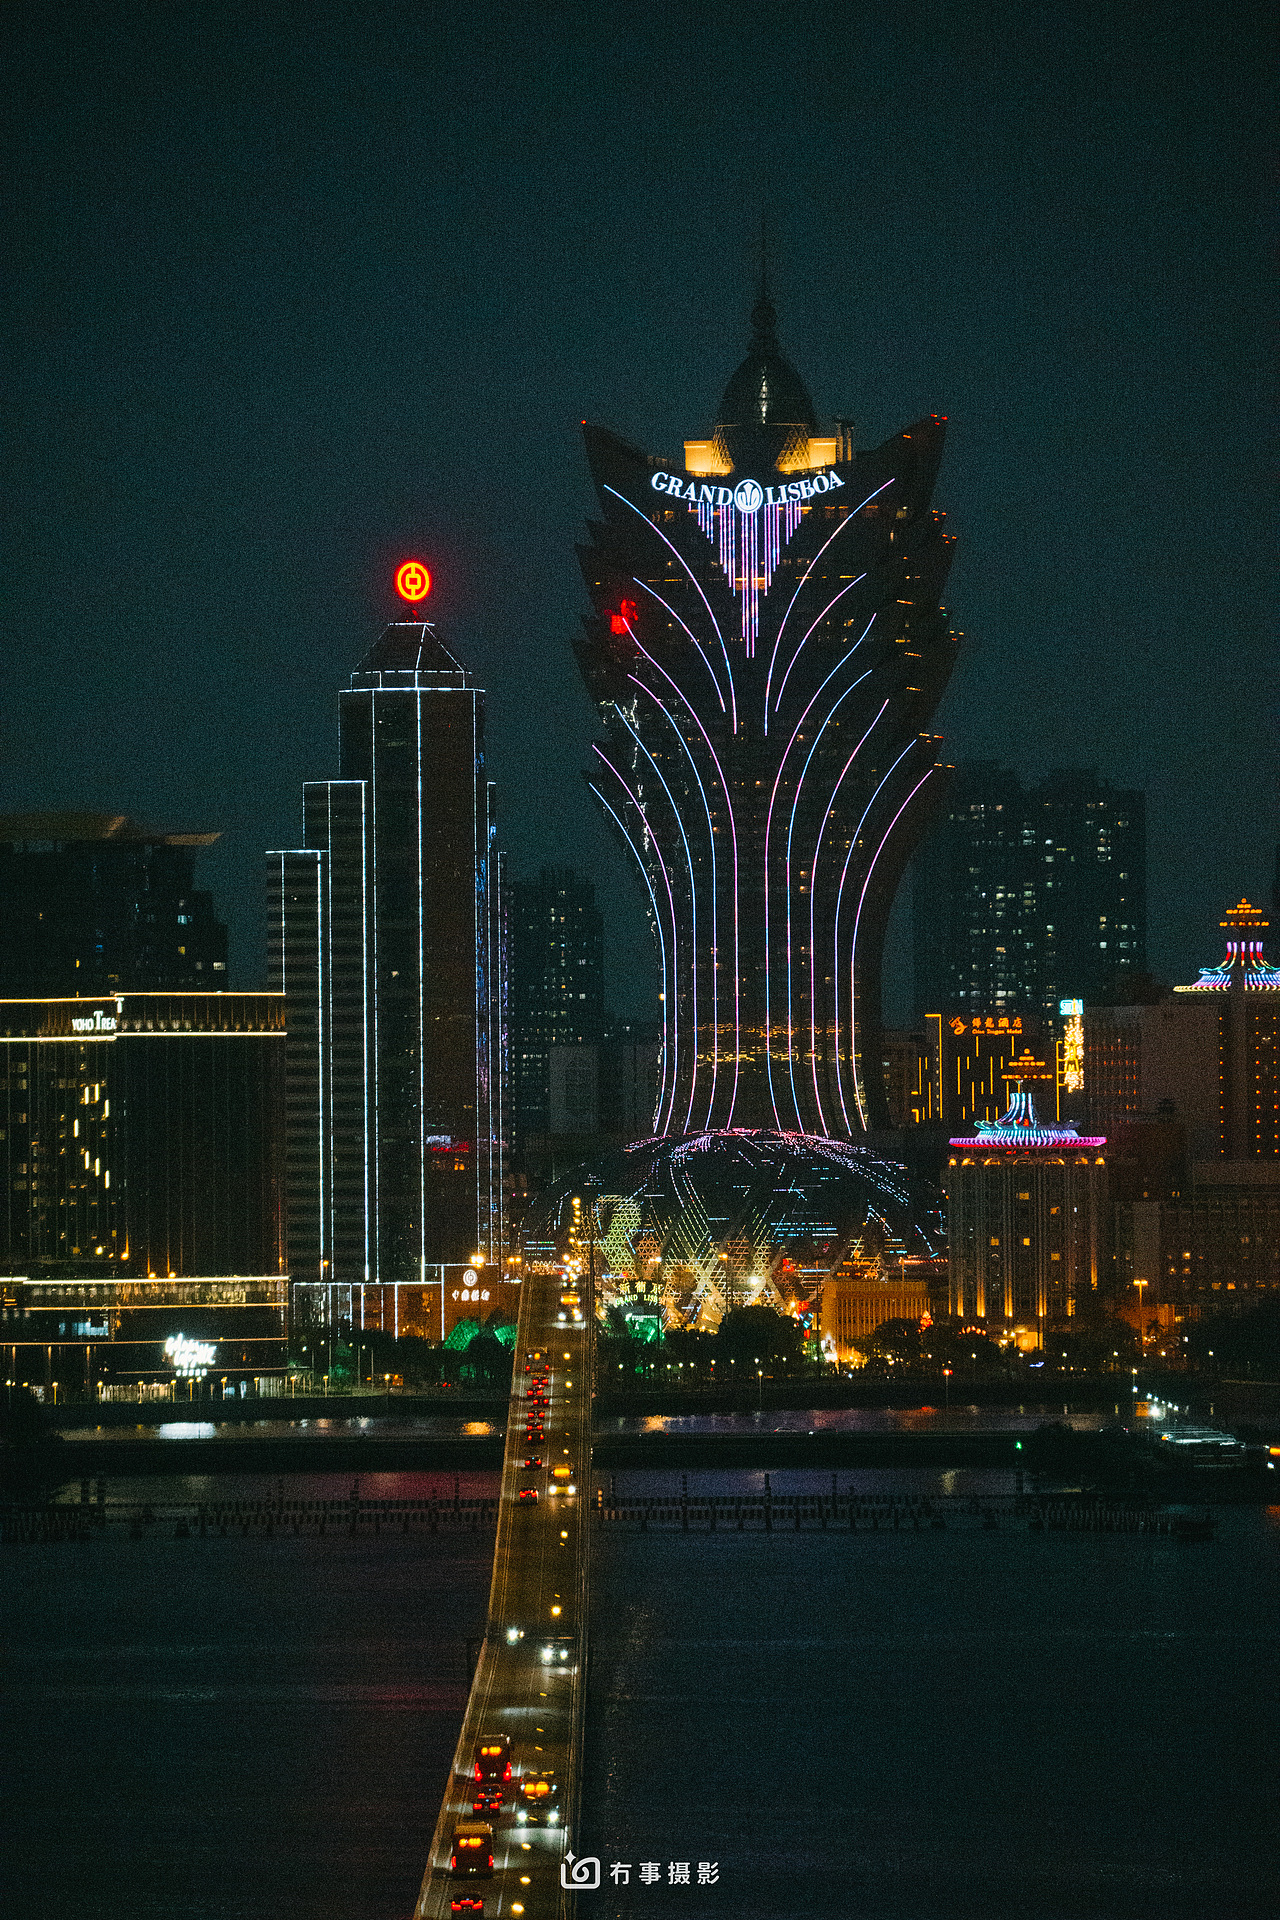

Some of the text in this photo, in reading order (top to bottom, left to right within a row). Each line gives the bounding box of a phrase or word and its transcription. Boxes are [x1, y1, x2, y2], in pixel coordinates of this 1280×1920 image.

[651, 470, 845, 506] GRAND LISBOA
[72, 1018, 95, 1031] YOHO
